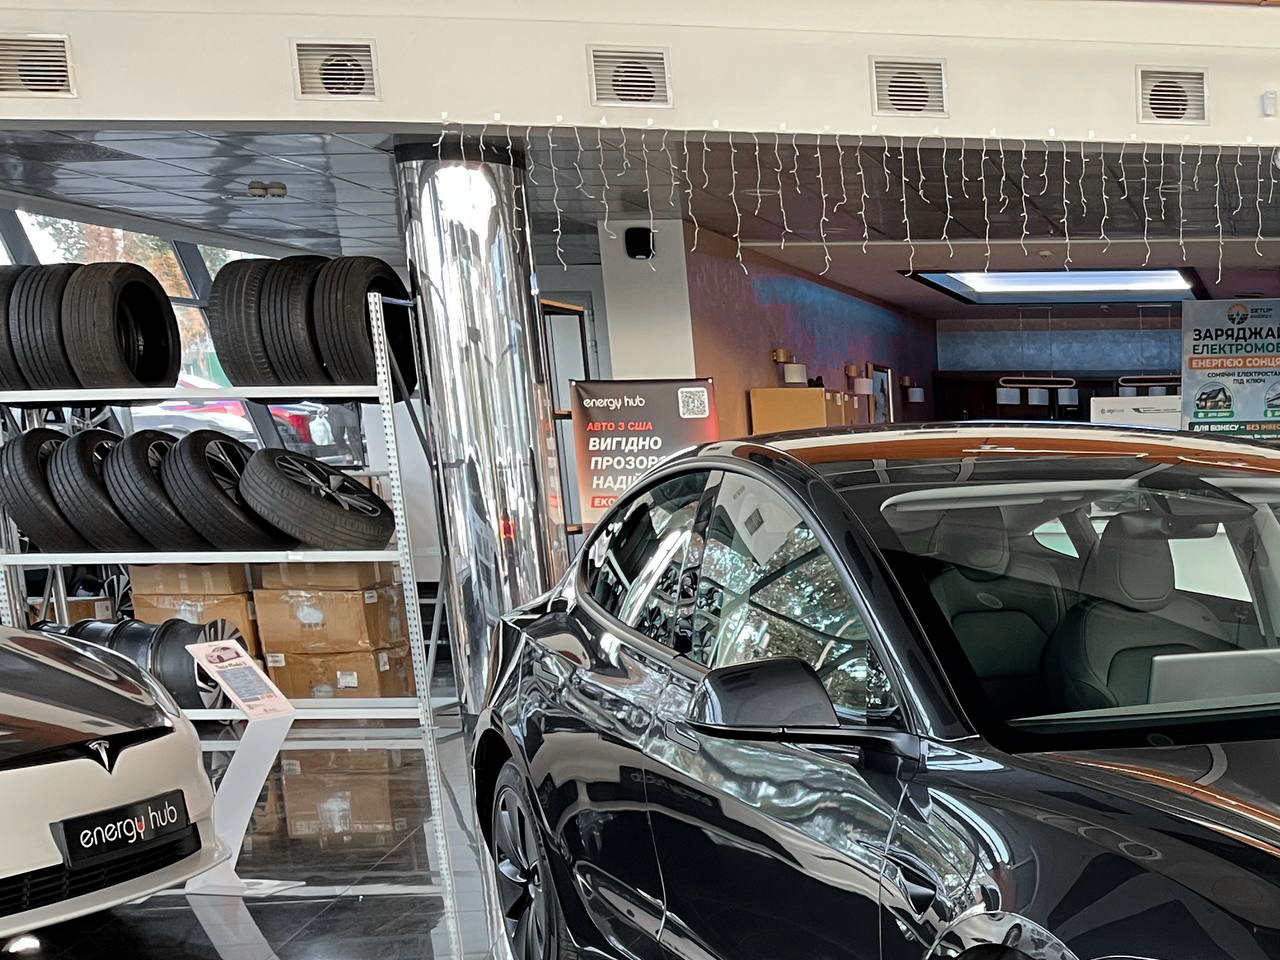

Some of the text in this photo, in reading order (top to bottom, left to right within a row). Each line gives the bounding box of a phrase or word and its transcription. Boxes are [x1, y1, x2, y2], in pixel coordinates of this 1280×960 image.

[1192, 358, 1244, 369] ЕНЕРГІЄЮ
[583, 395, 646, 410] energy hub
[587, 422, 615, 431] АВТО
[627, 422, 653, 431] США
[589, 436, 662, 453] ВИГІДНО
[80, 801, 177, 848] energy hub
